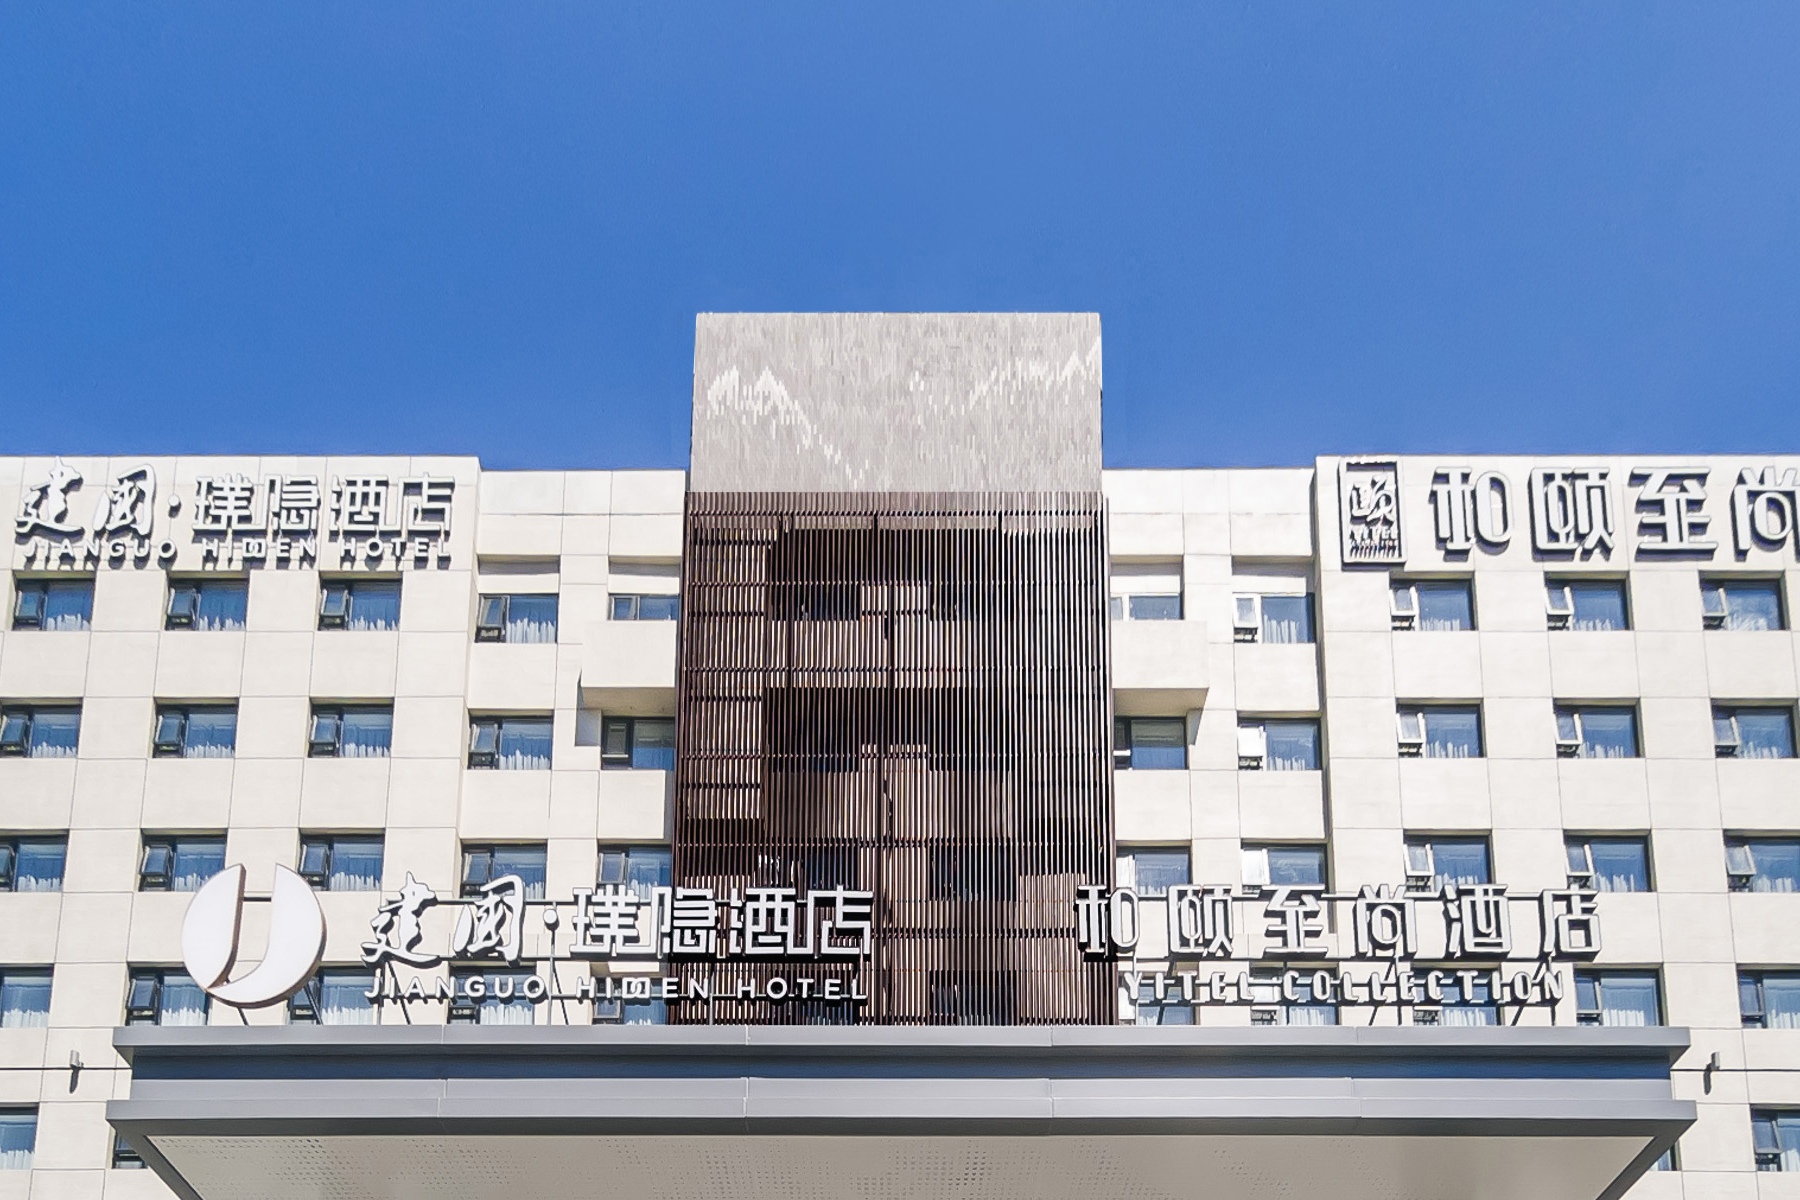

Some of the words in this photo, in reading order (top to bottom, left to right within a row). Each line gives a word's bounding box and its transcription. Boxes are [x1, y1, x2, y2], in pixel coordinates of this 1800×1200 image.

[23, 538, 177, 559] JIANGUO
[340, 537, 452, 558] HOTEL
[1075, 884, 1602, 953] 和颐至尚酒店
[364, 975, 546, 998] JIANGUO
[737, 977, 868, 1000] HOTEL
[1123, 970, 1255, 1001] YITEL
[1282, 970, 1563, 1001] COLLECTION
